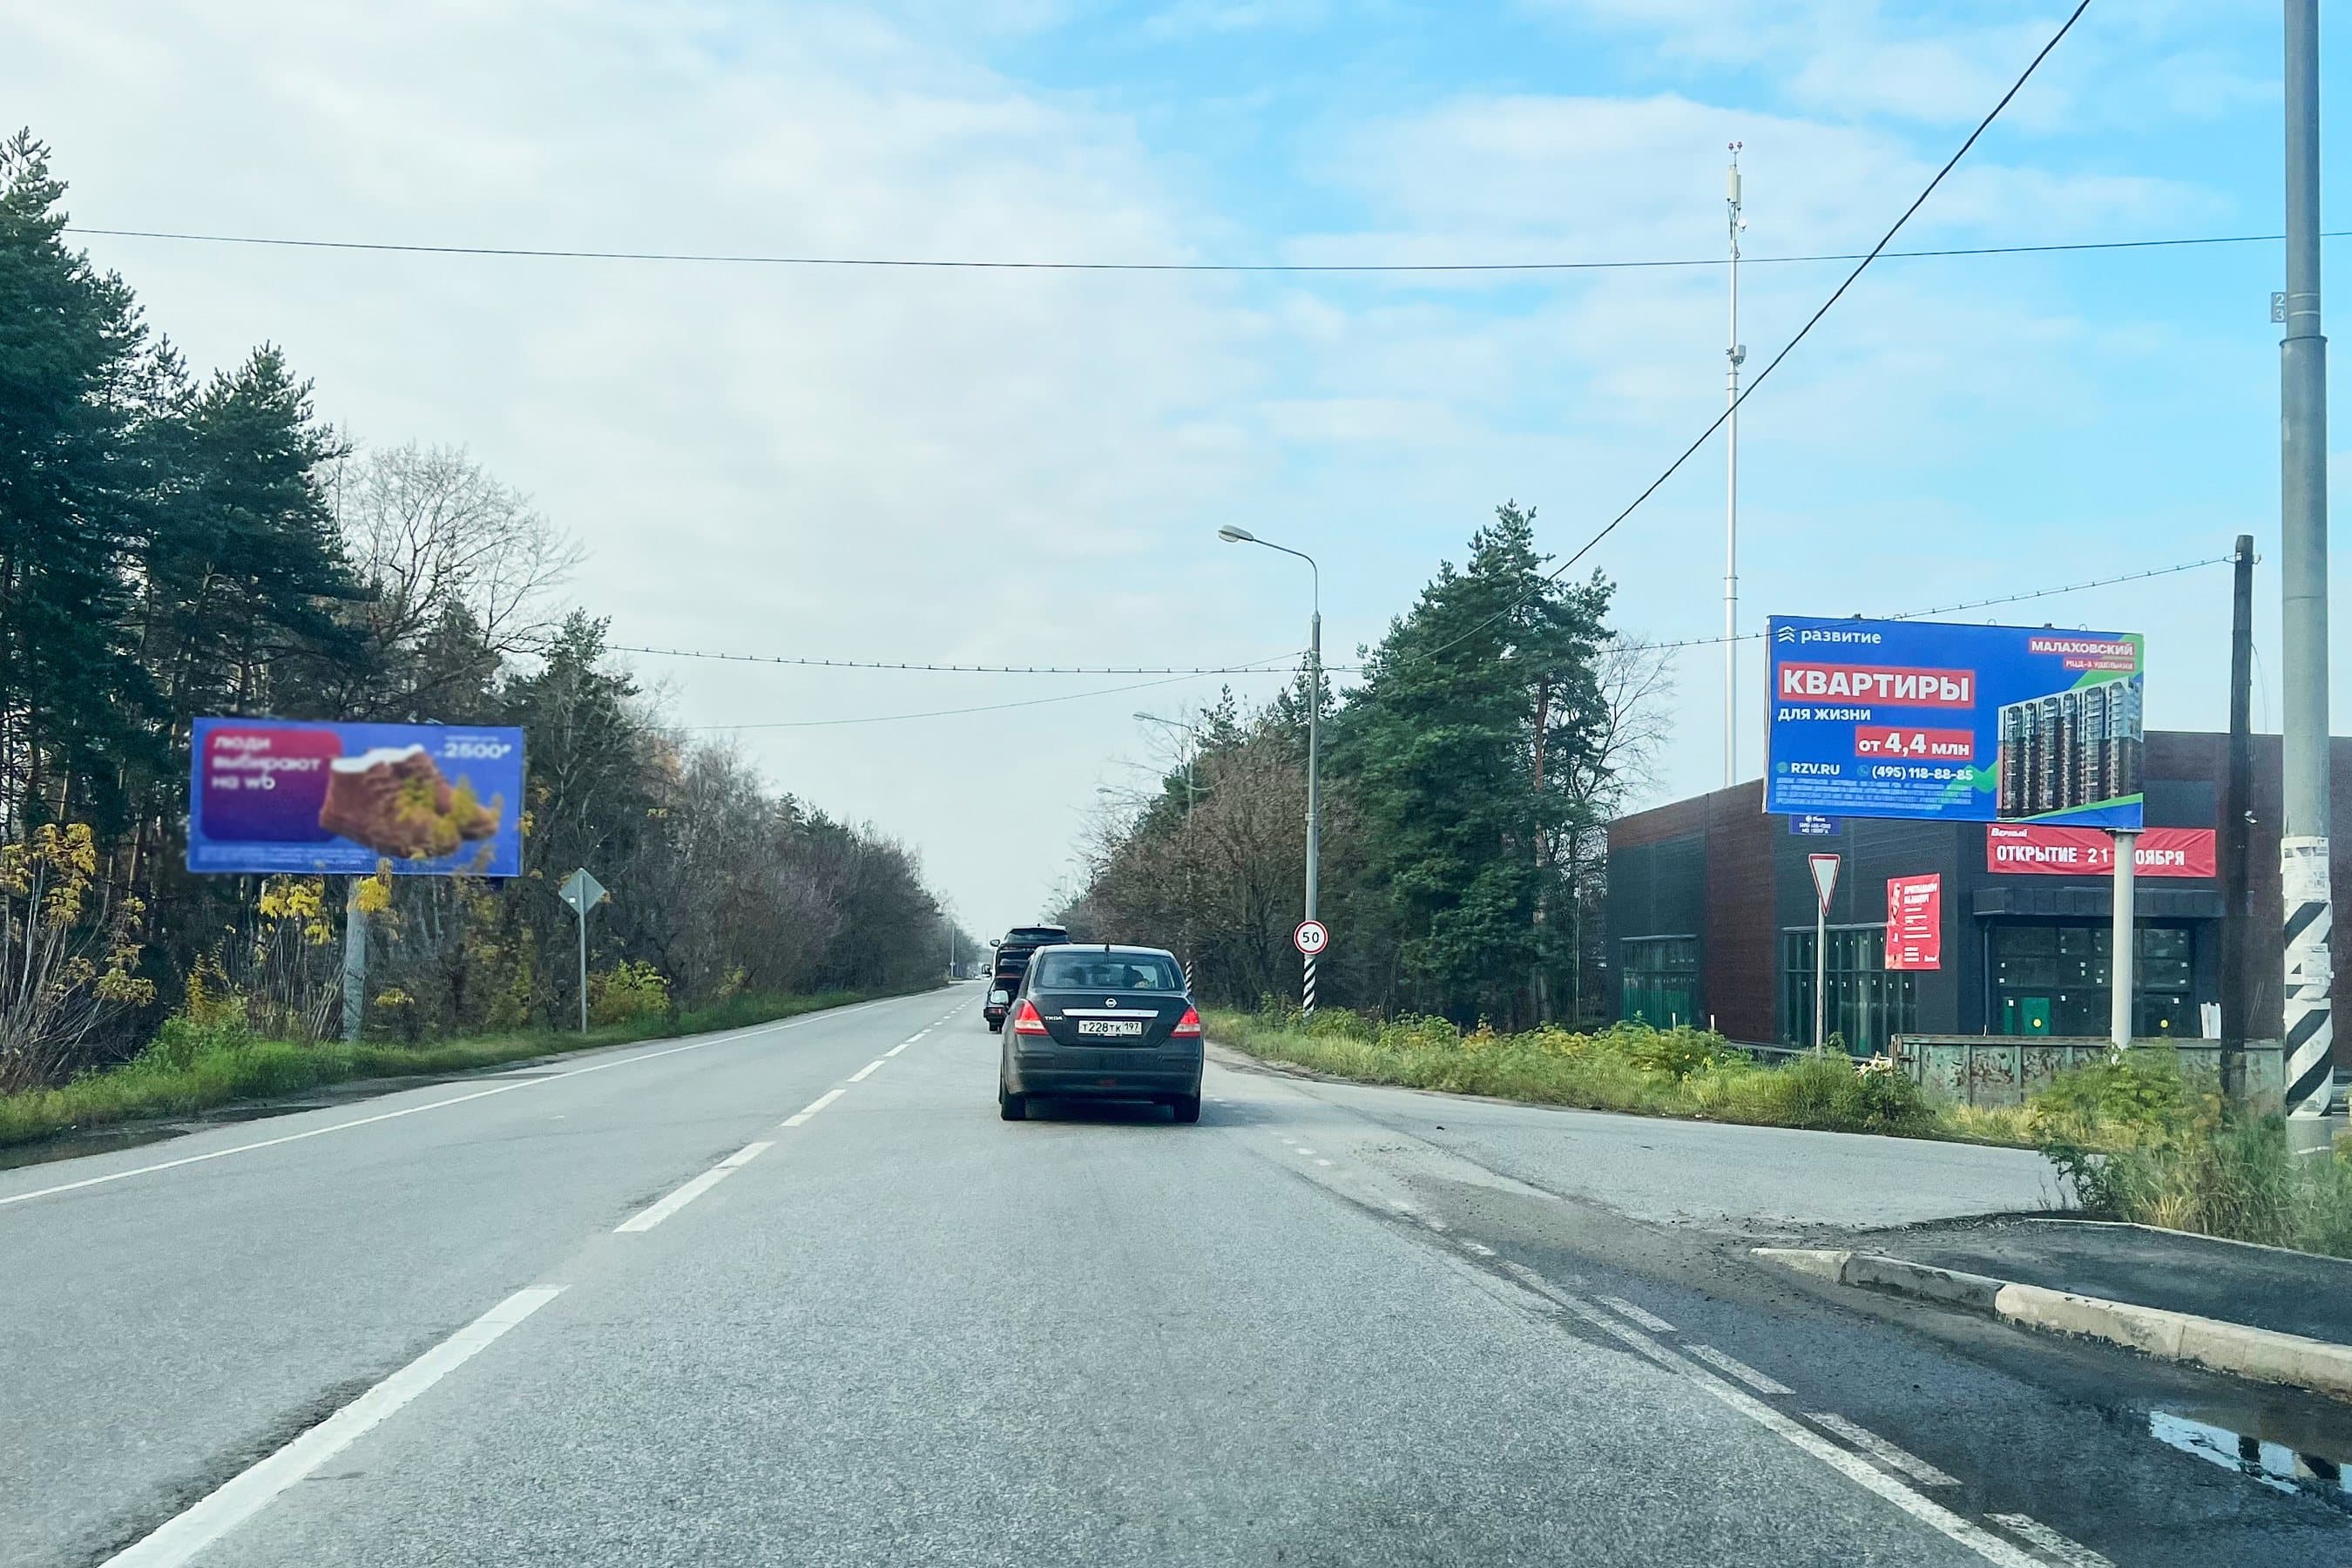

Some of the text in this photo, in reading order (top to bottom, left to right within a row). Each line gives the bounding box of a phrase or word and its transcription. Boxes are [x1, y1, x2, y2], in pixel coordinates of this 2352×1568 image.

[1801, 630, 1882, 644] развитие
[2031, 640, 2133, 655] МАЛАХОВСКИЙ
[1783, 669, 1969, 701] КВАРТИРЫ
[1858, 733, 1970, 757] от 4,4 млн
[1791, 762, 1974, 781] RZV.RU (495) 118-88-85
[1996, 845, 2185, 866] ОТКРЫТИЕ 21 ОЯБРЯ
[1302, 931, 1320, 943] 50
[1124, 1022, 1139, 1031] 197
